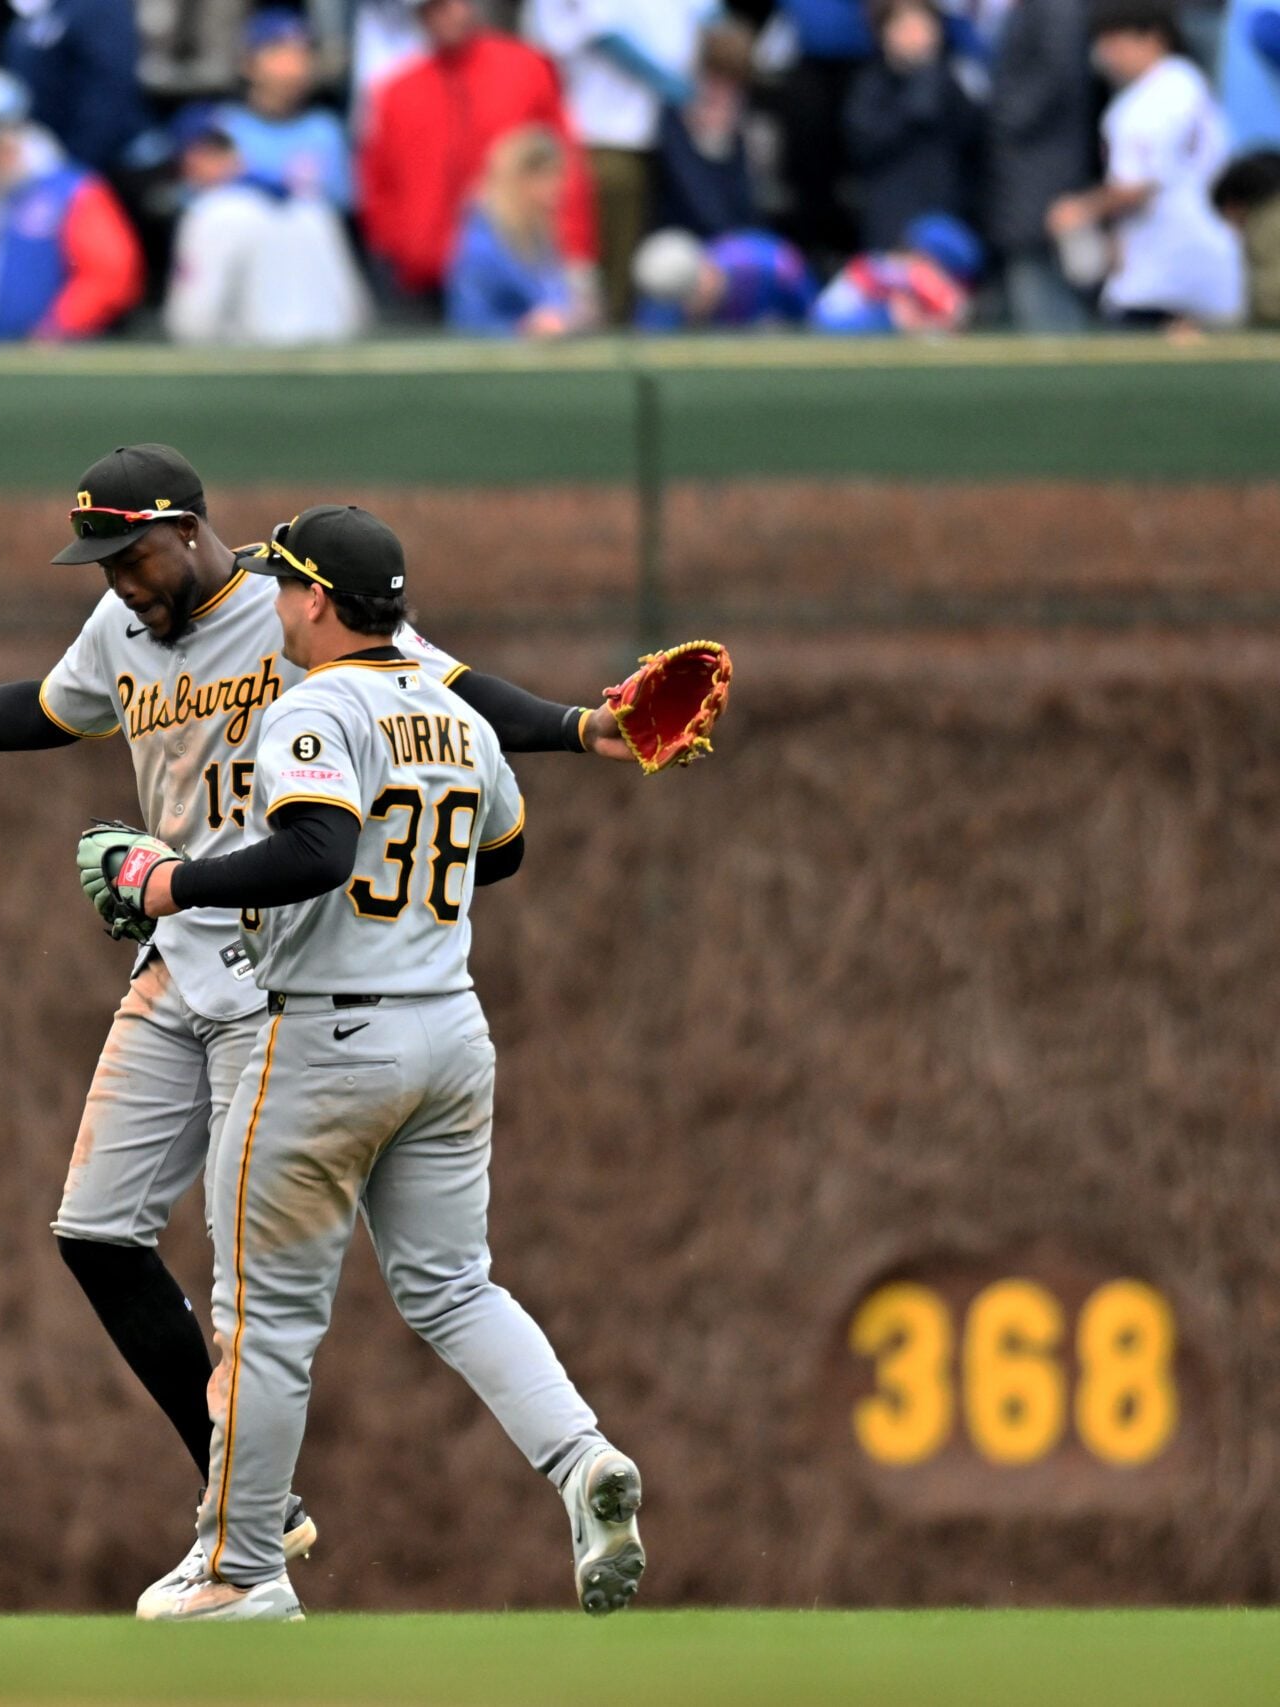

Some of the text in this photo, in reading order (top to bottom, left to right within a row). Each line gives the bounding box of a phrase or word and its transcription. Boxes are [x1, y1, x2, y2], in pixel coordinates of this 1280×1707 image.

[299, 736, 314, 759] 9
[376, 713, 476, 769] YORKE
[203, 760, 256, 831] 15
[345, 784, 481, 925] 38
[849, 1276, 1179, 1469] 368
